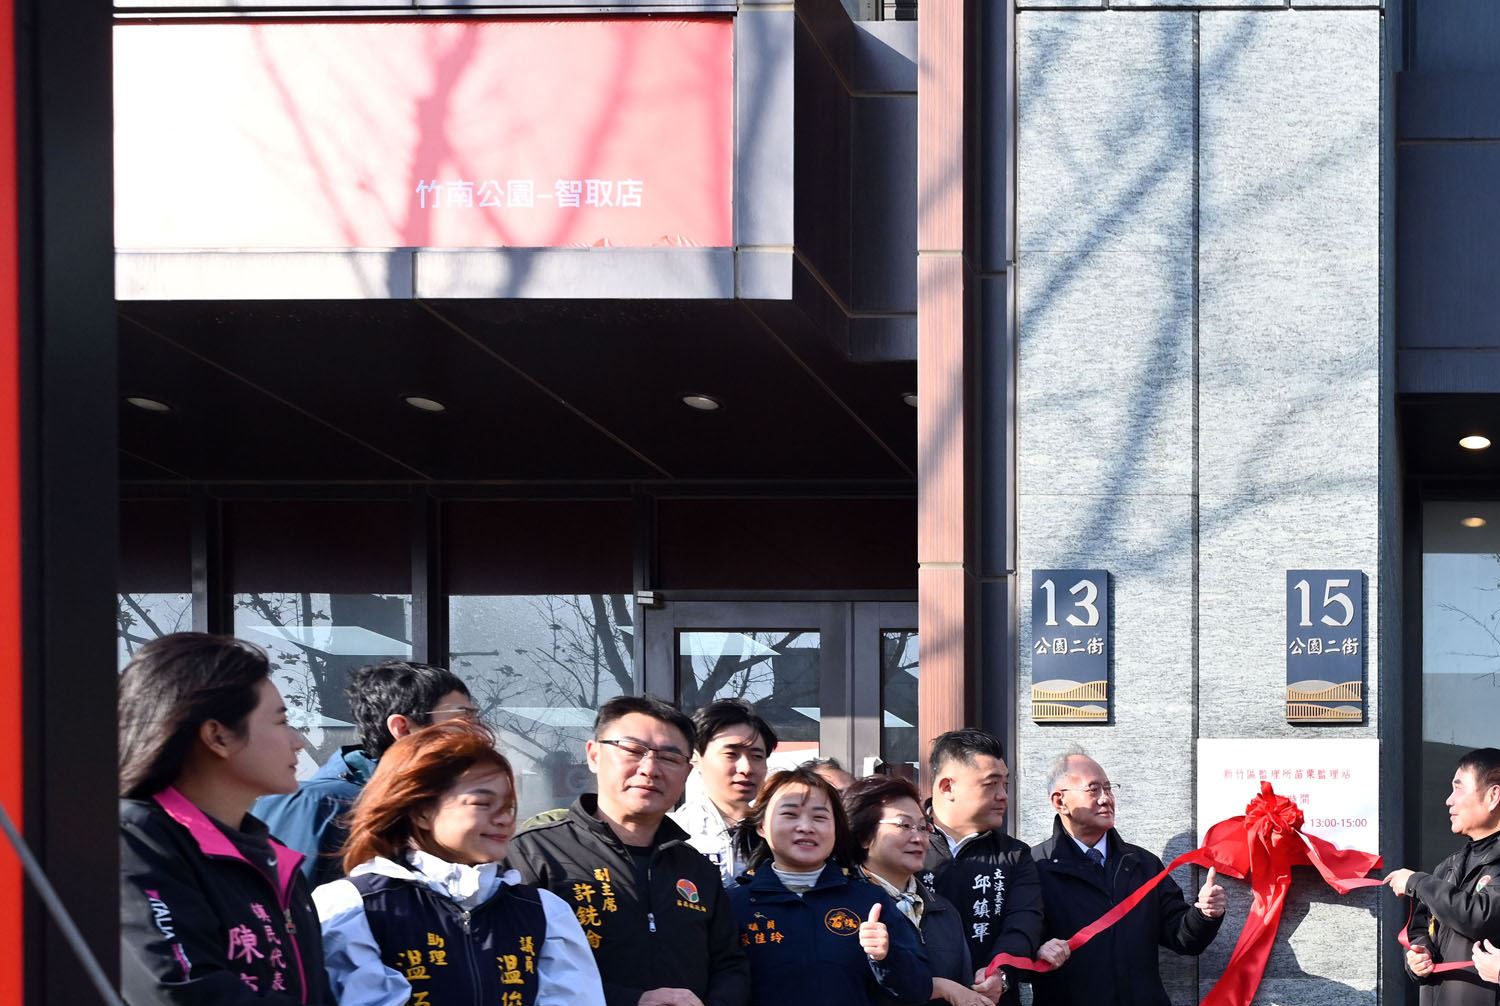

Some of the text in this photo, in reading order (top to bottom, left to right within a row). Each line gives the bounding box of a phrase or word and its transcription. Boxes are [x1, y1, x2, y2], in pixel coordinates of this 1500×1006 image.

[1040, 579, 1100, 627] 13
[1294, 579, 1354, 627] 15
[1034, 637, 1104, 656] 公園二街
[1289, 637, 1359, 656] 公園二街
[1310, 818, 1367, 828] 13:00-15:00
[972, 874, 991, 943] 邱鎮軍
[426, 932, 449, 966] 助理
